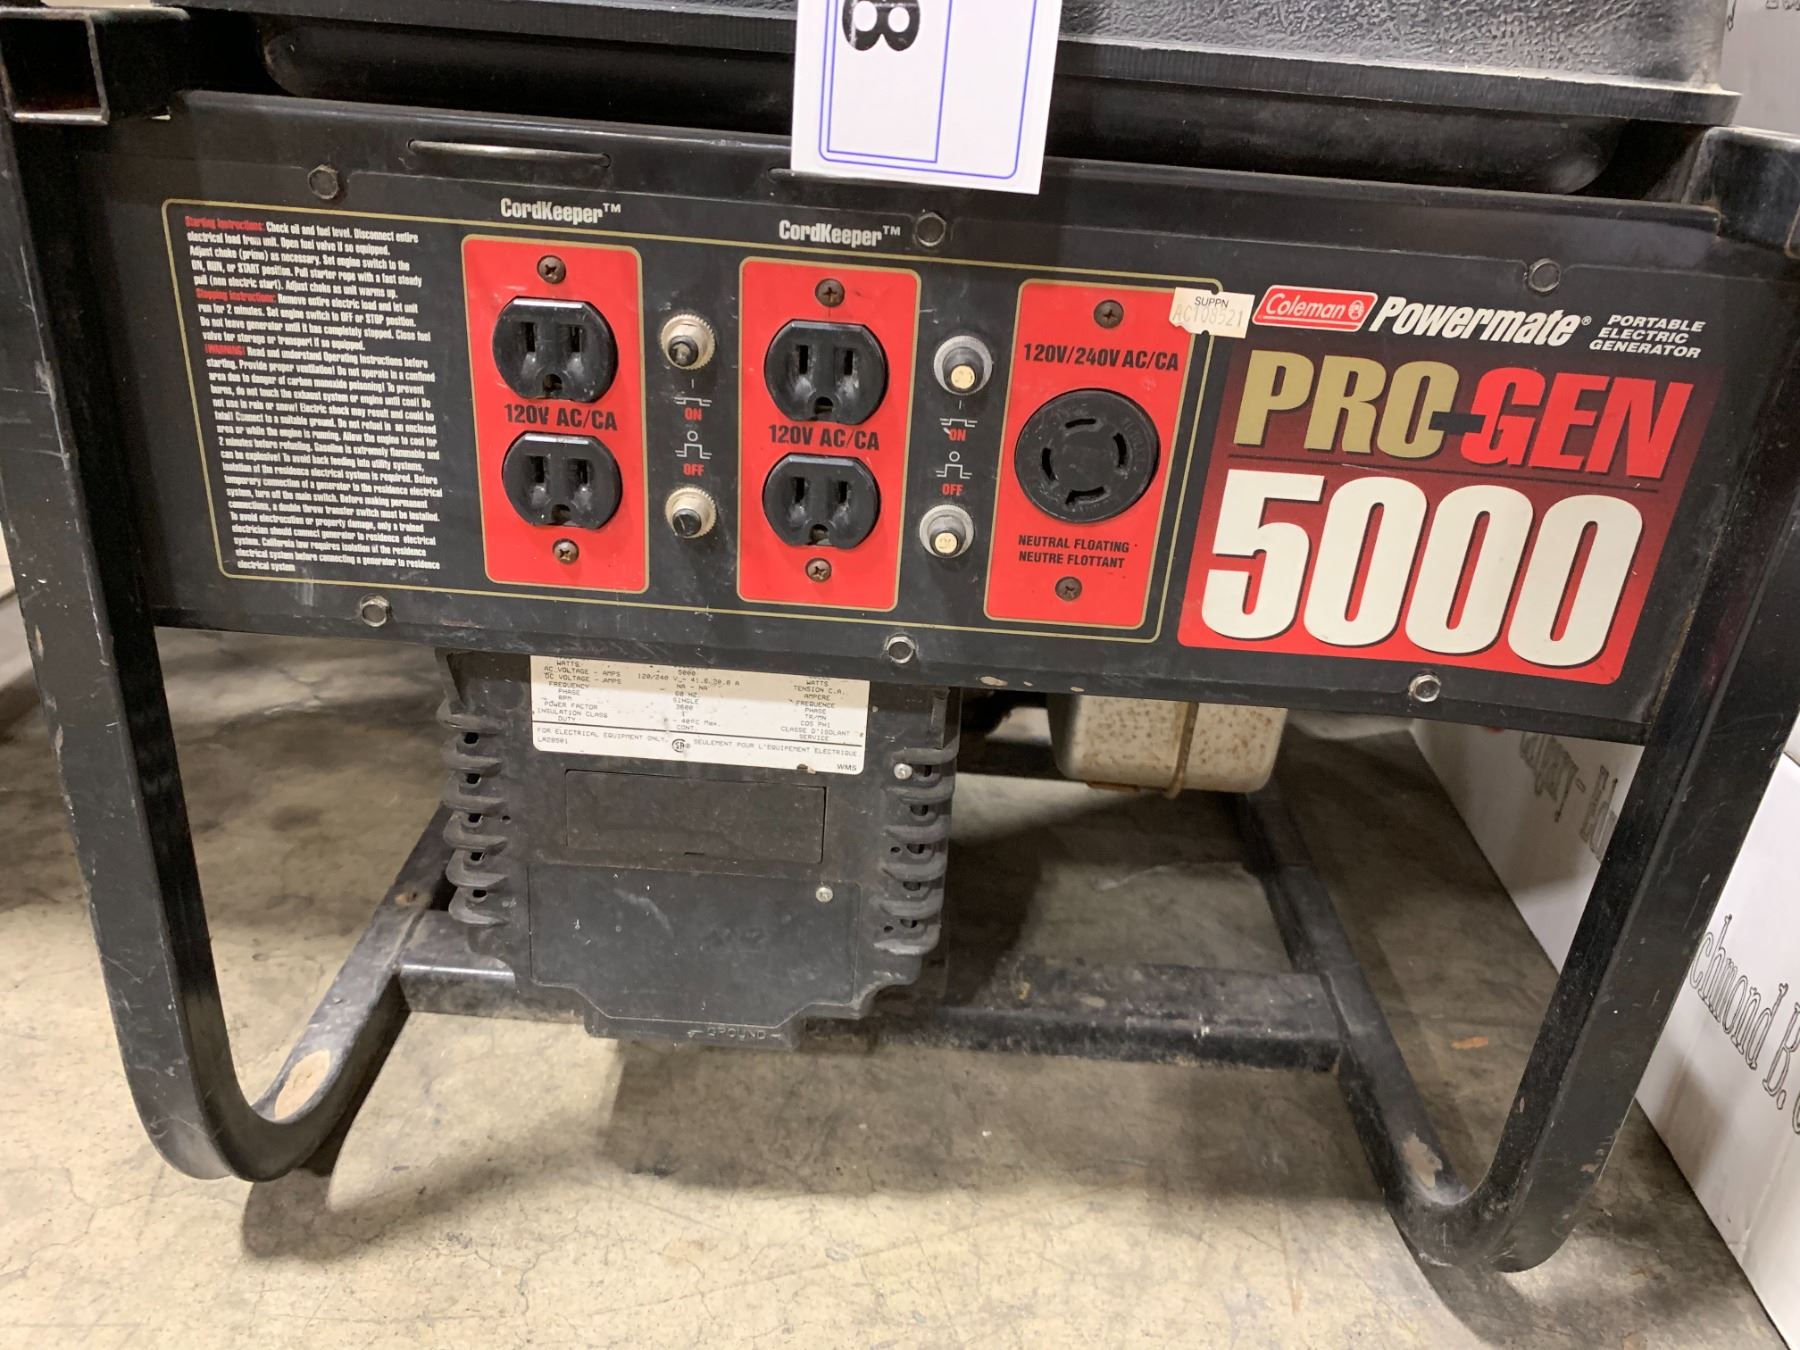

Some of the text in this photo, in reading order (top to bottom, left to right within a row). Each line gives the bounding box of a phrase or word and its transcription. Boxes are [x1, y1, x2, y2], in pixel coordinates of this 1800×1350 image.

[1195, 296, 1229, 309] SUPPN
[1265, 292, 1345, 319] Coleman
[1607, 314, 1706, 332] PORTABLE
[1597, 327, 1689, 344] ELECTRIC
[1024, 343, 1179, 371] 120V/240V AC/CA
[1589, 339, 1701, 358] GENERATOR
[504, 404, 618, 432] 120V AC/CA
[684, 407, 703, 421] ON
[1233, 350, 1693, 479] PRO-GEN
[769, 425, 880, 450] 120V AC/CA
[949, 428, 967, 441] ON
[683, 463, 704, 476] OFF
[942, 483, 964, 496] OFF
[1018, 534, 1130, 553] NEUTRAL FLOATING
[1018, 551, 1125, 569] NEUTRE FLOTTANT
[1201, 469, 1643, 666] 5000
